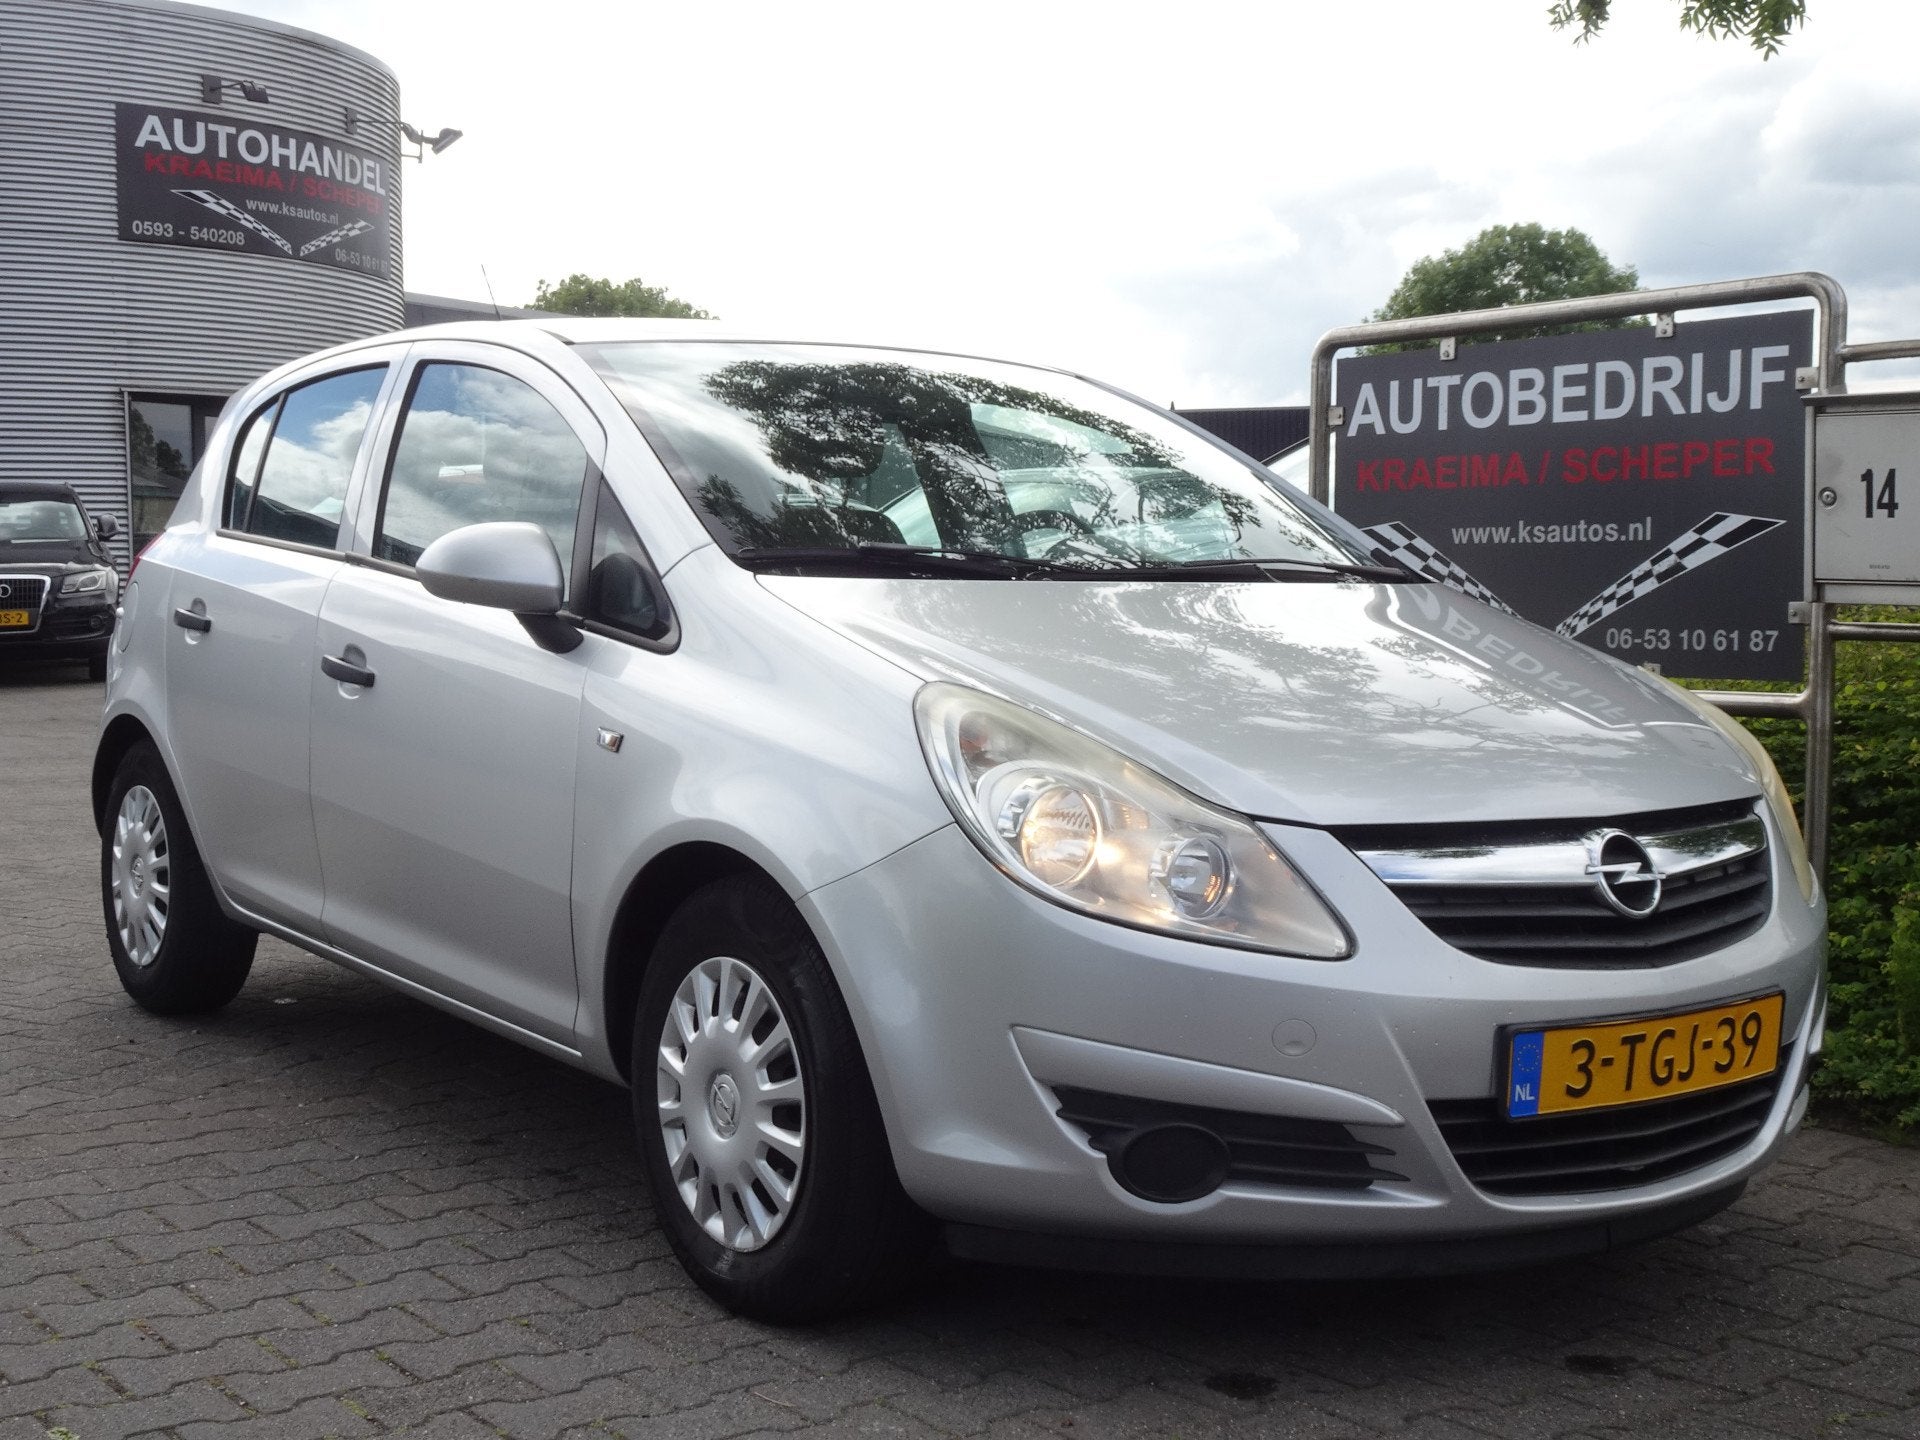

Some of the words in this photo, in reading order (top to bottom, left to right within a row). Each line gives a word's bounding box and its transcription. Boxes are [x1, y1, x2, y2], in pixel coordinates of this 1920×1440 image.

[134, 114, 386, 196] AUTOHANDEL
[144, 151, 284, 191] KRAEIMA
[289, 175, 297, 192] /
[246, 199, 339, 226] www.ksautos.nl
[132, 220, 174, 238] 0593
[190, 226, 246, 246] 540208
[335, 248, 360, 266] 06-53
[1346, 345, 1790, 438] AUTOBEDRIJF
[1357, 452, 1529, 492] KRAEIMA
[1538, 451, 1552, 485] /
[1562, 437, 1776, 484] SCHEPER
[1860, 468, 1899, 519] 14
[1452, 516, 1653, 545] www.ksautos.nl
[1606, 628, 1671, 650] 06-53
[1679, 629, 1706, 651] 10
[1713, 629, 1739, 651] 61
[1750, 630, 1779, 652] 87
[1565, 1010, 1764, 1098] 3-TGJ-39
[1515, 1084, 1535, 1102] NL
